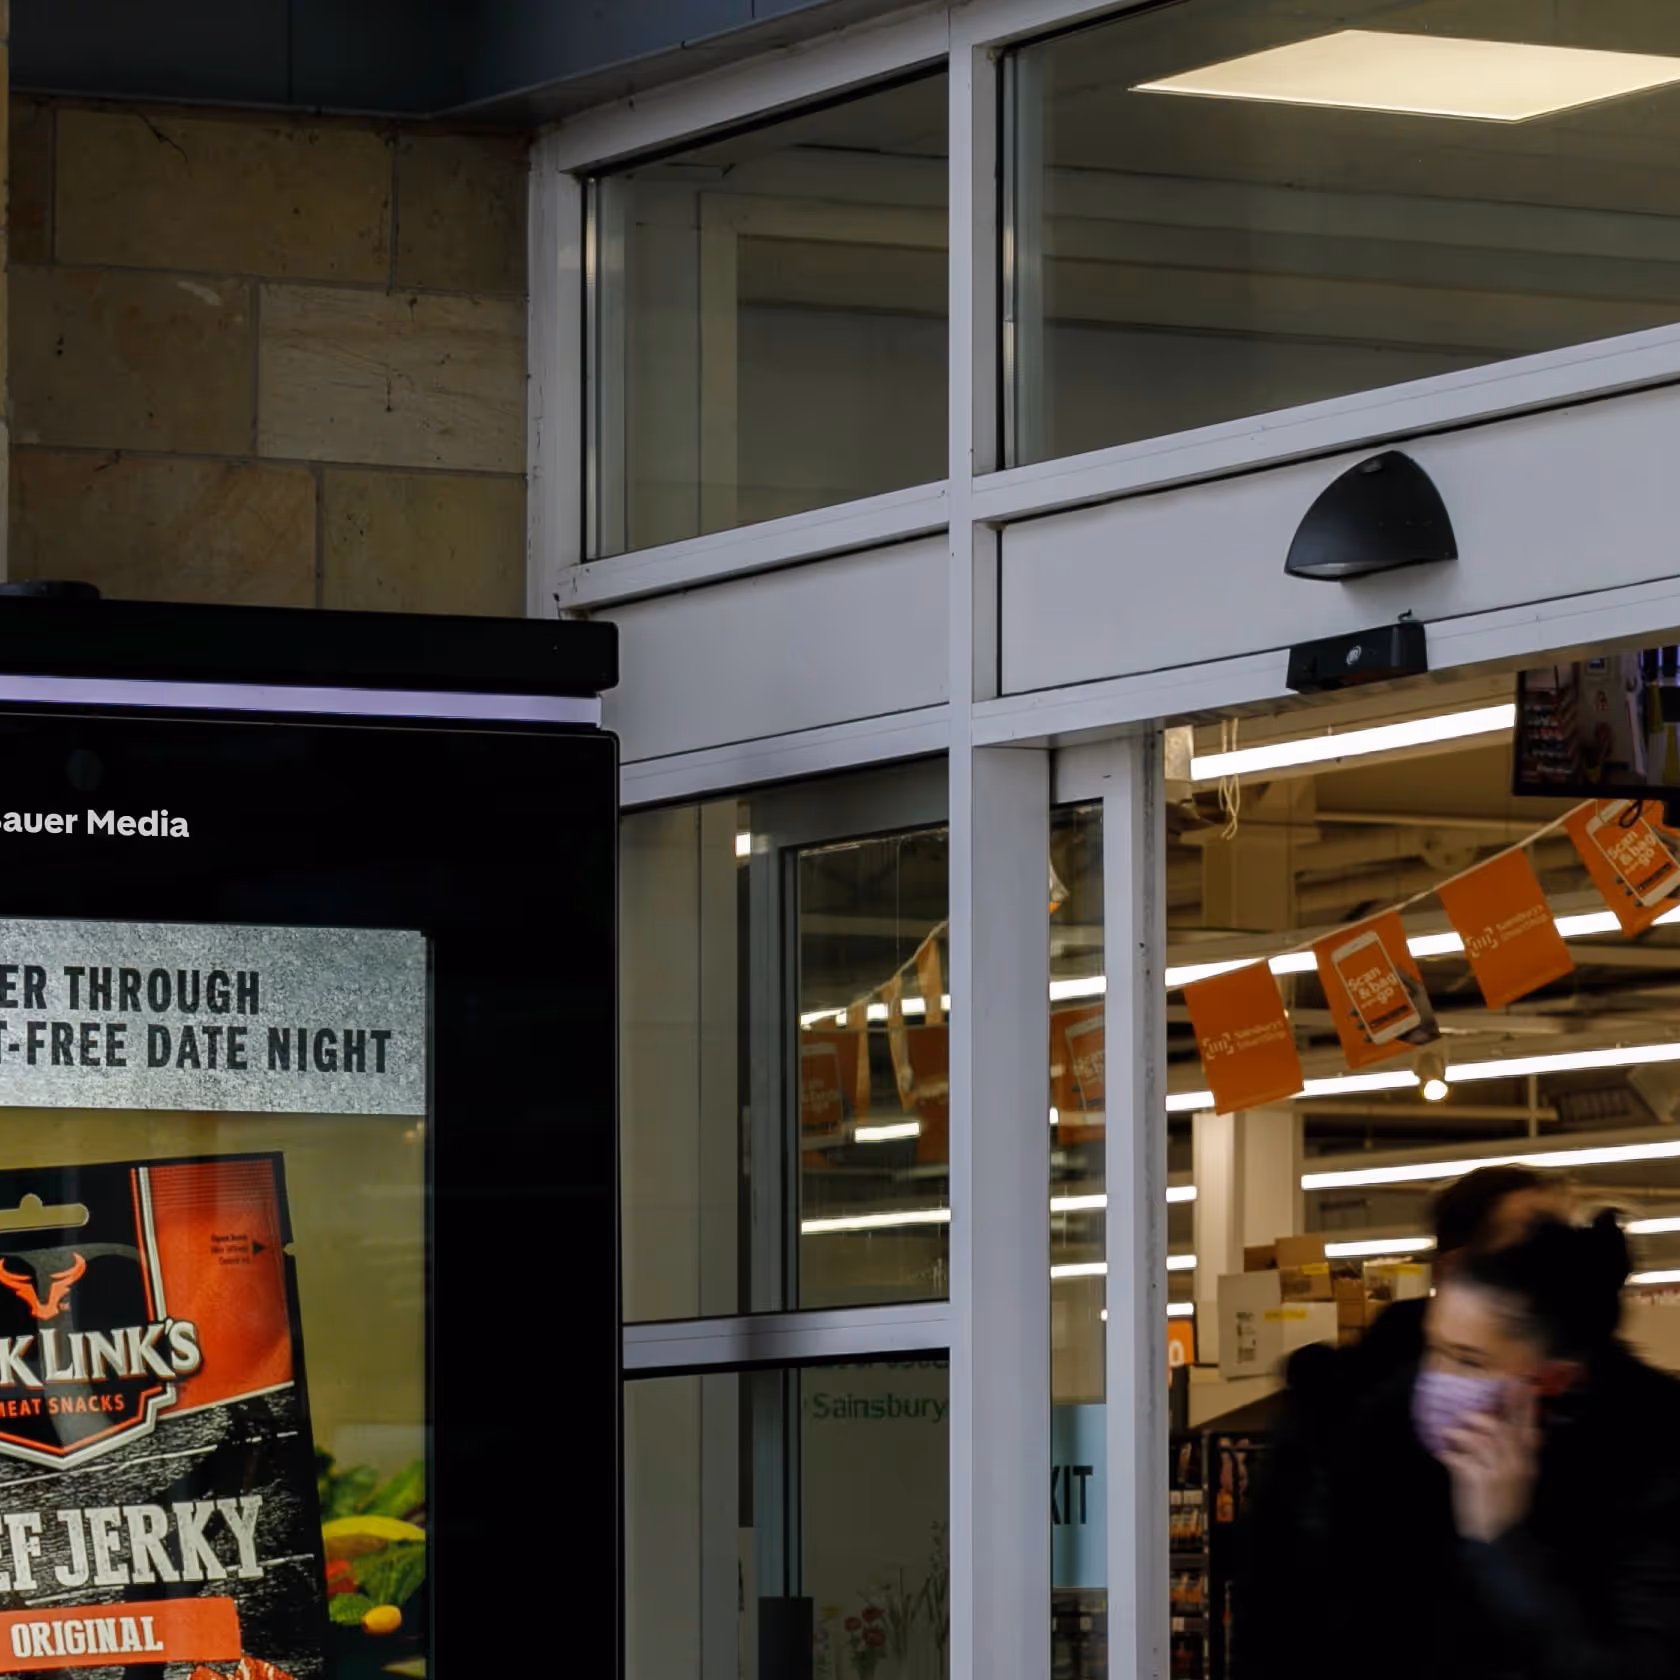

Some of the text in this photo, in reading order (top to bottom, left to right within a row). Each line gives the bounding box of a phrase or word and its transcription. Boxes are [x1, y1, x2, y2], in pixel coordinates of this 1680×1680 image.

[87, 810, 190, 837] Media
[64, 966, 260, 1015] THROUGH
[1348, 967, 1381, 991] Scan
[148, 1025, 248, 1070] DATE
[268, 1029, 392, 1073] NIGHT
[40, 1318, 202, 1380] LINK'S
[49, 1393, 125, 1414] SNACKS
[55, 1495, 264, 1587] JERKY
[11, 1615, 163, 1659] ORIGINAL
